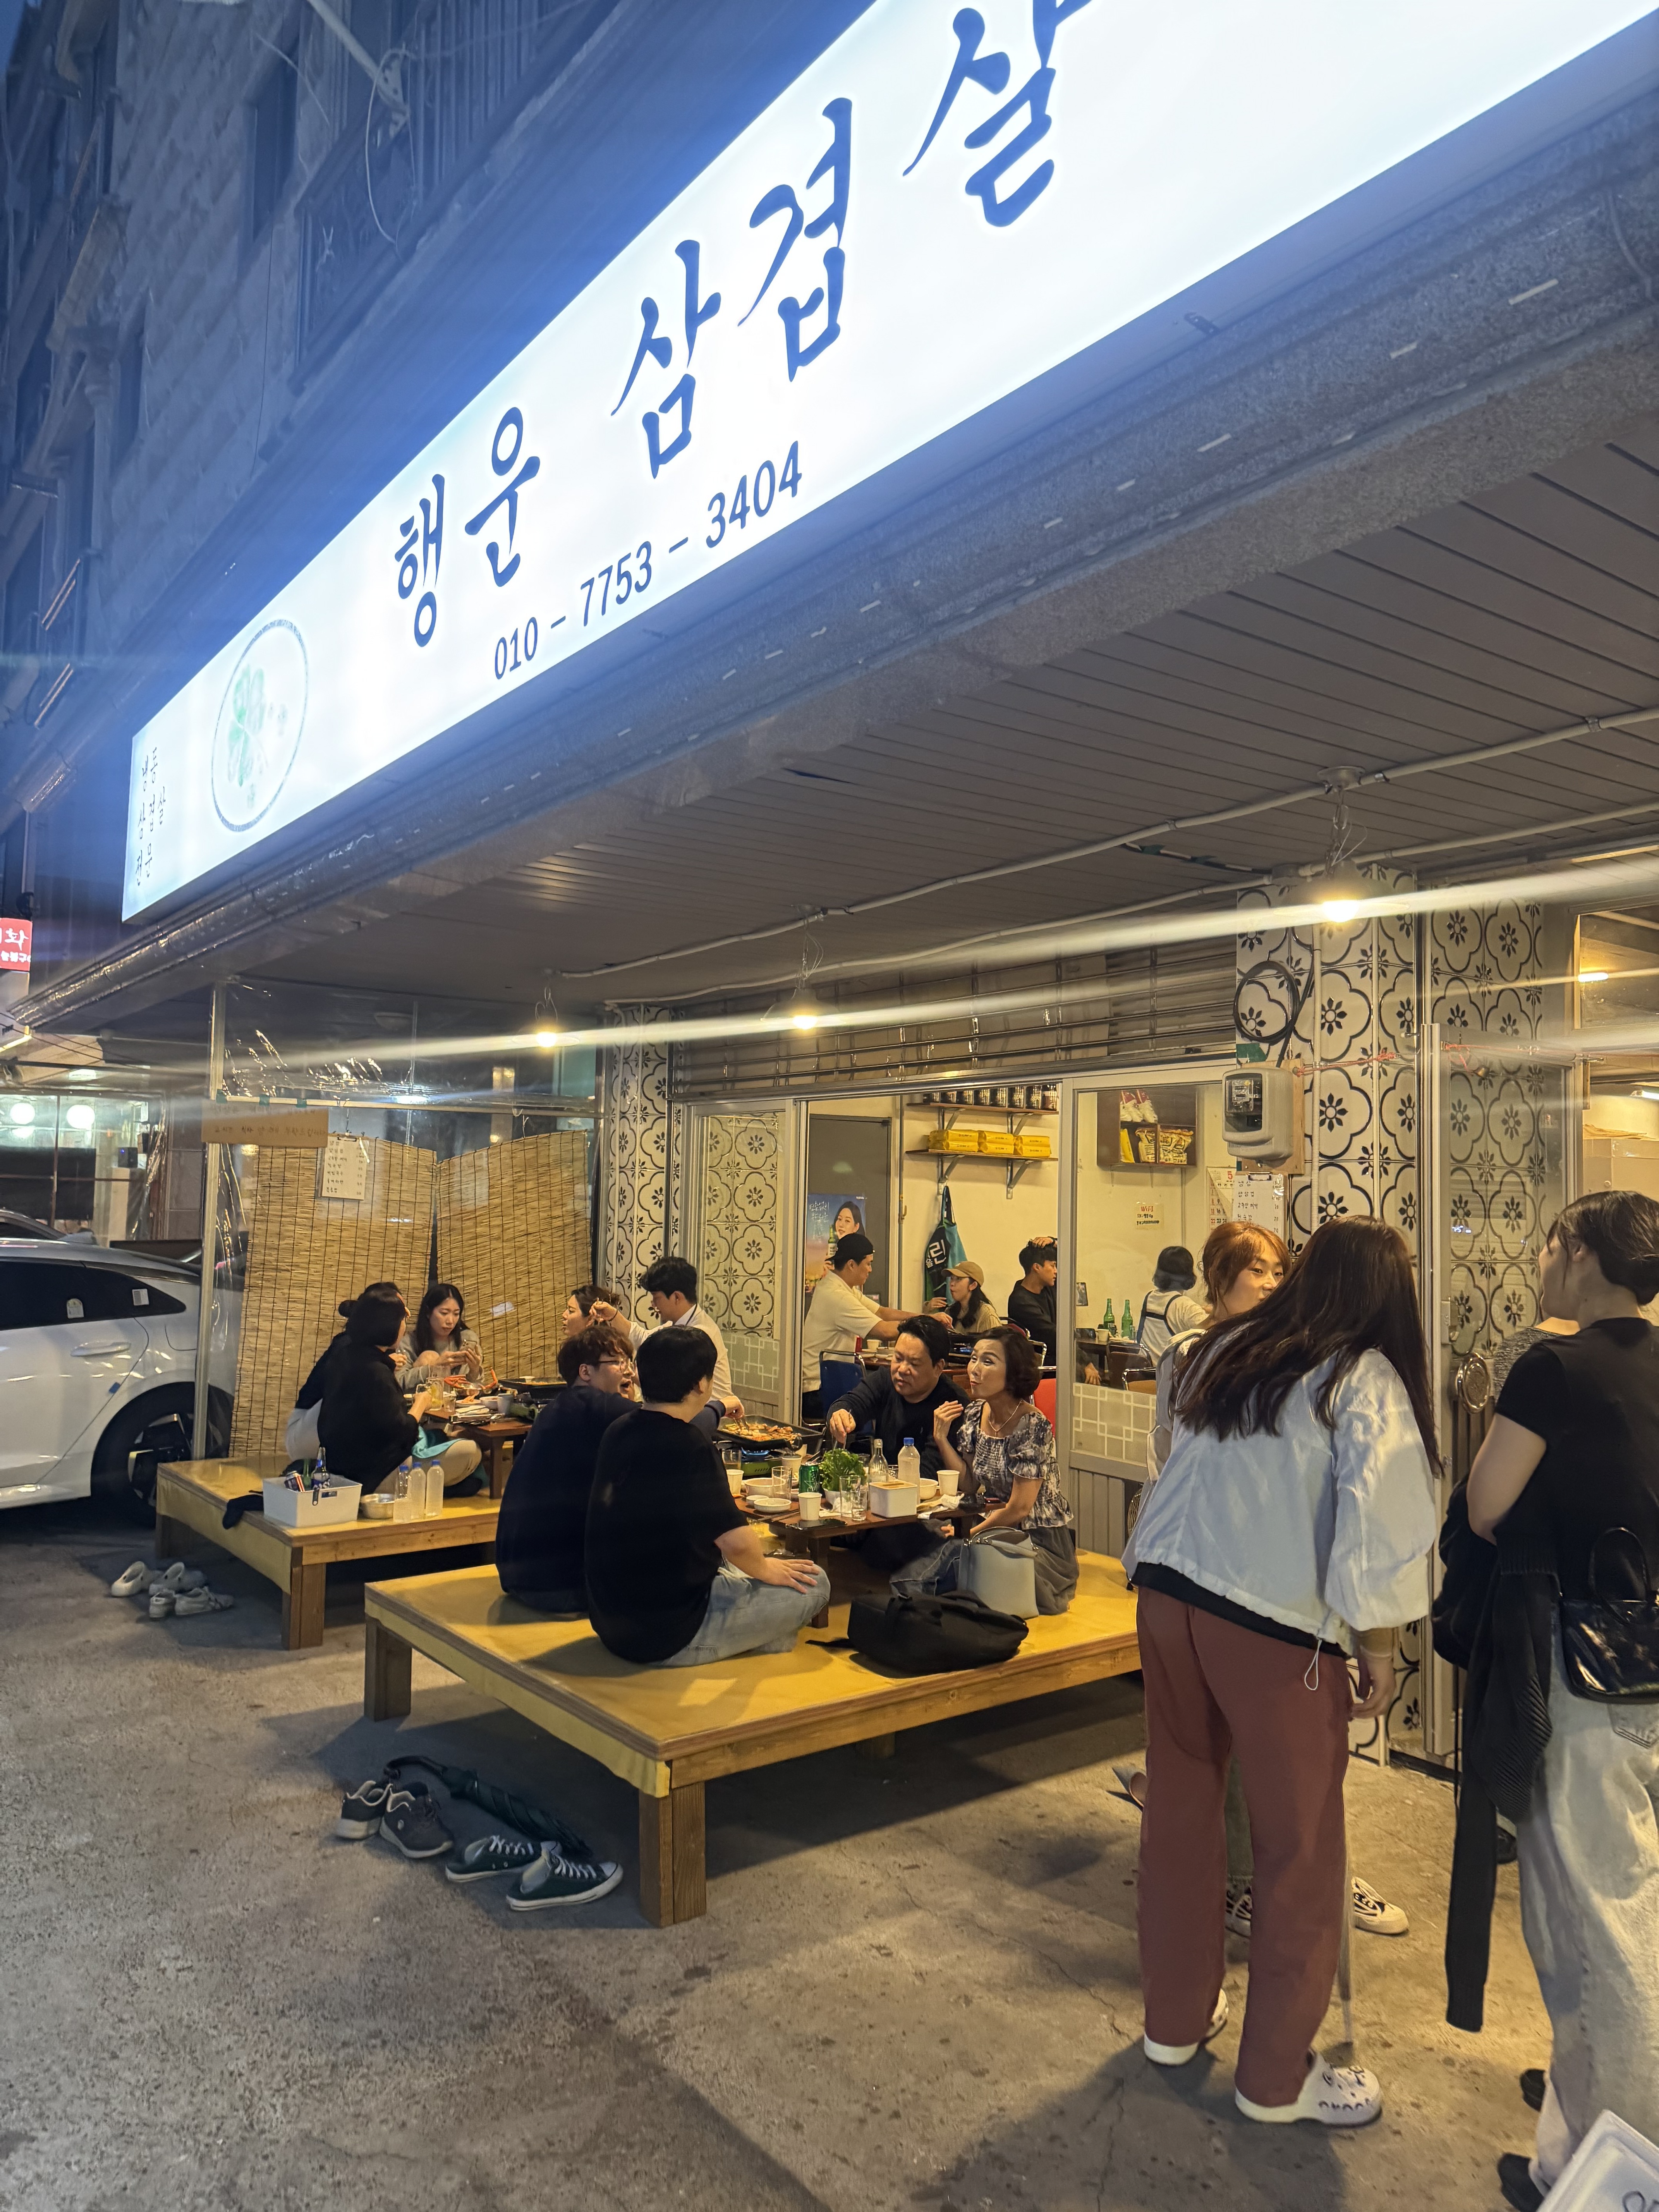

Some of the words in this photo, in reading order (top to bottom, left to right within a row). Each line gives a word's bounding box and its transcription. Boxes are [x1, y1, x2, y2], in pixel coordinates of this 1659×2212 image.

[395, 407, 540, 647] 행운
[610, 0, 1092, 479] 삼겹살
[495, 617, 538, 680] 010
[580, 541, 652, 627] 7753
[706, 440, 802, 548] 3404
[136, 843, 152, 886] 전문
[1228, 1171, 1233, 1180] 5
